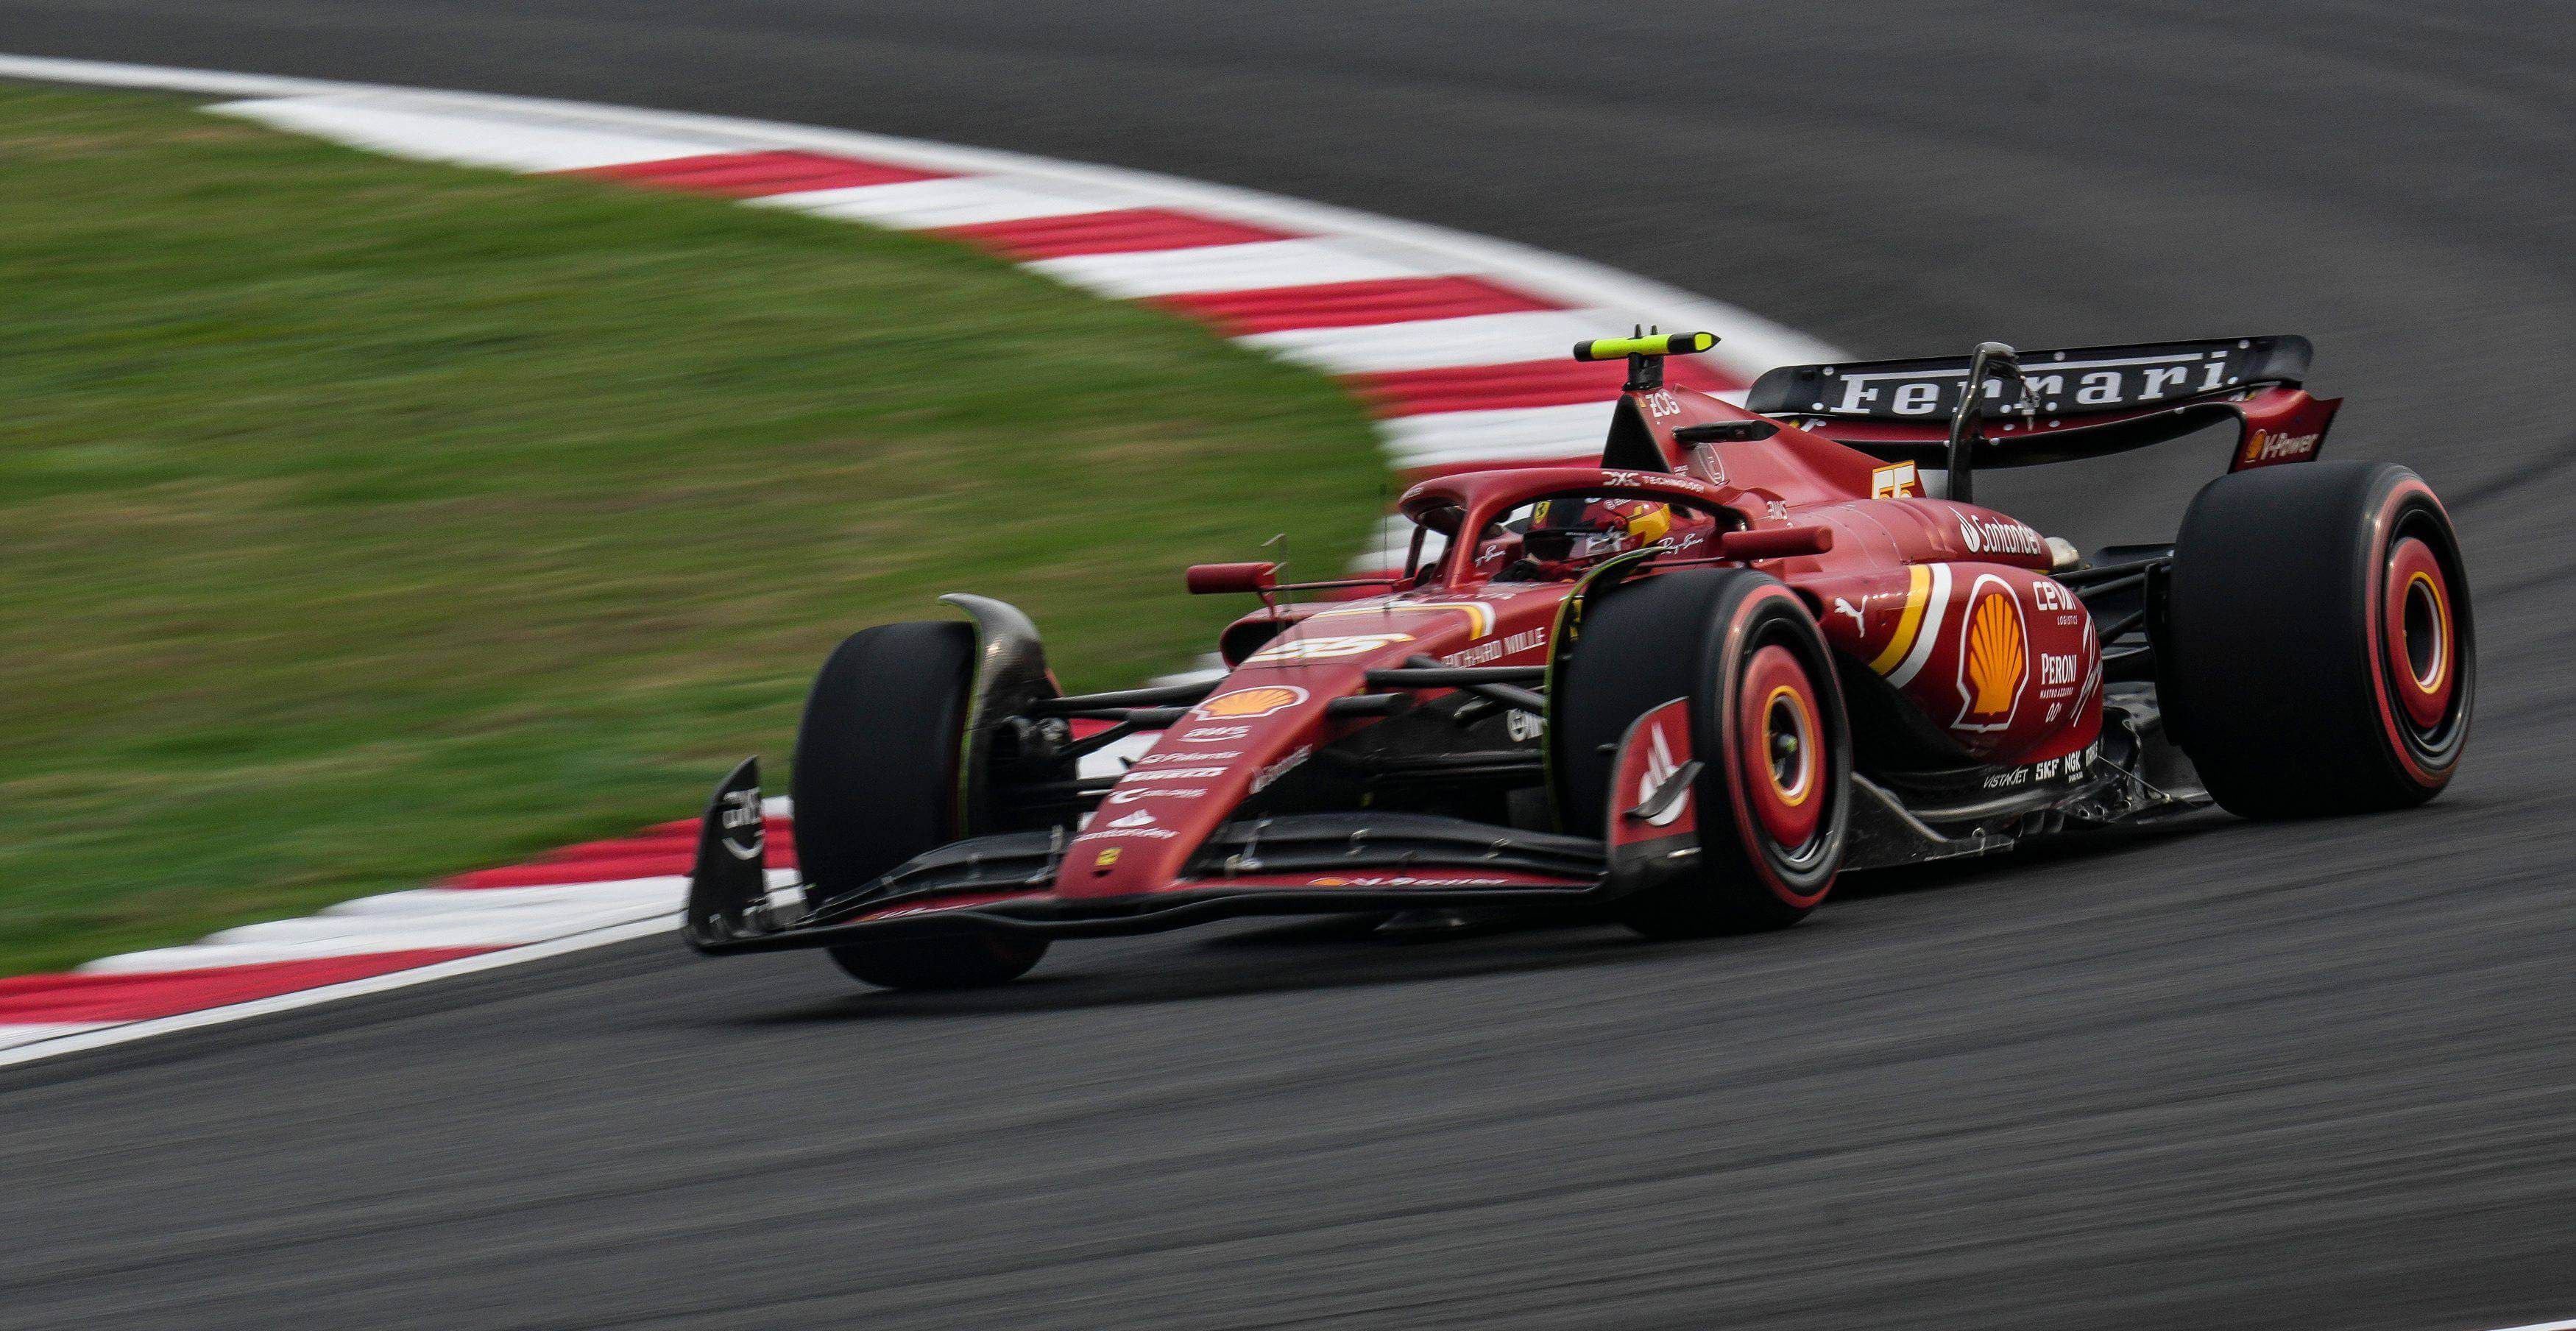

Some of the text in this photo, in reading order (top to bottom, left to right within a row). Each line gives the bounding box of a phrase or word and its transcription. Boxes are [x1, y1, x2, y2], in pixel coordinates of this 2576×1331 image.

[1830, 351, 2228, 415] Ferrari
[1645, 392, 1681, 418] ZCG
[1971, 515, 2042, 555] Santander
[2041, 652, 2078, 685] PERONI
[2035, 758, 2060, 782] SKF
[2064, 749, 2081, 774] NGK
